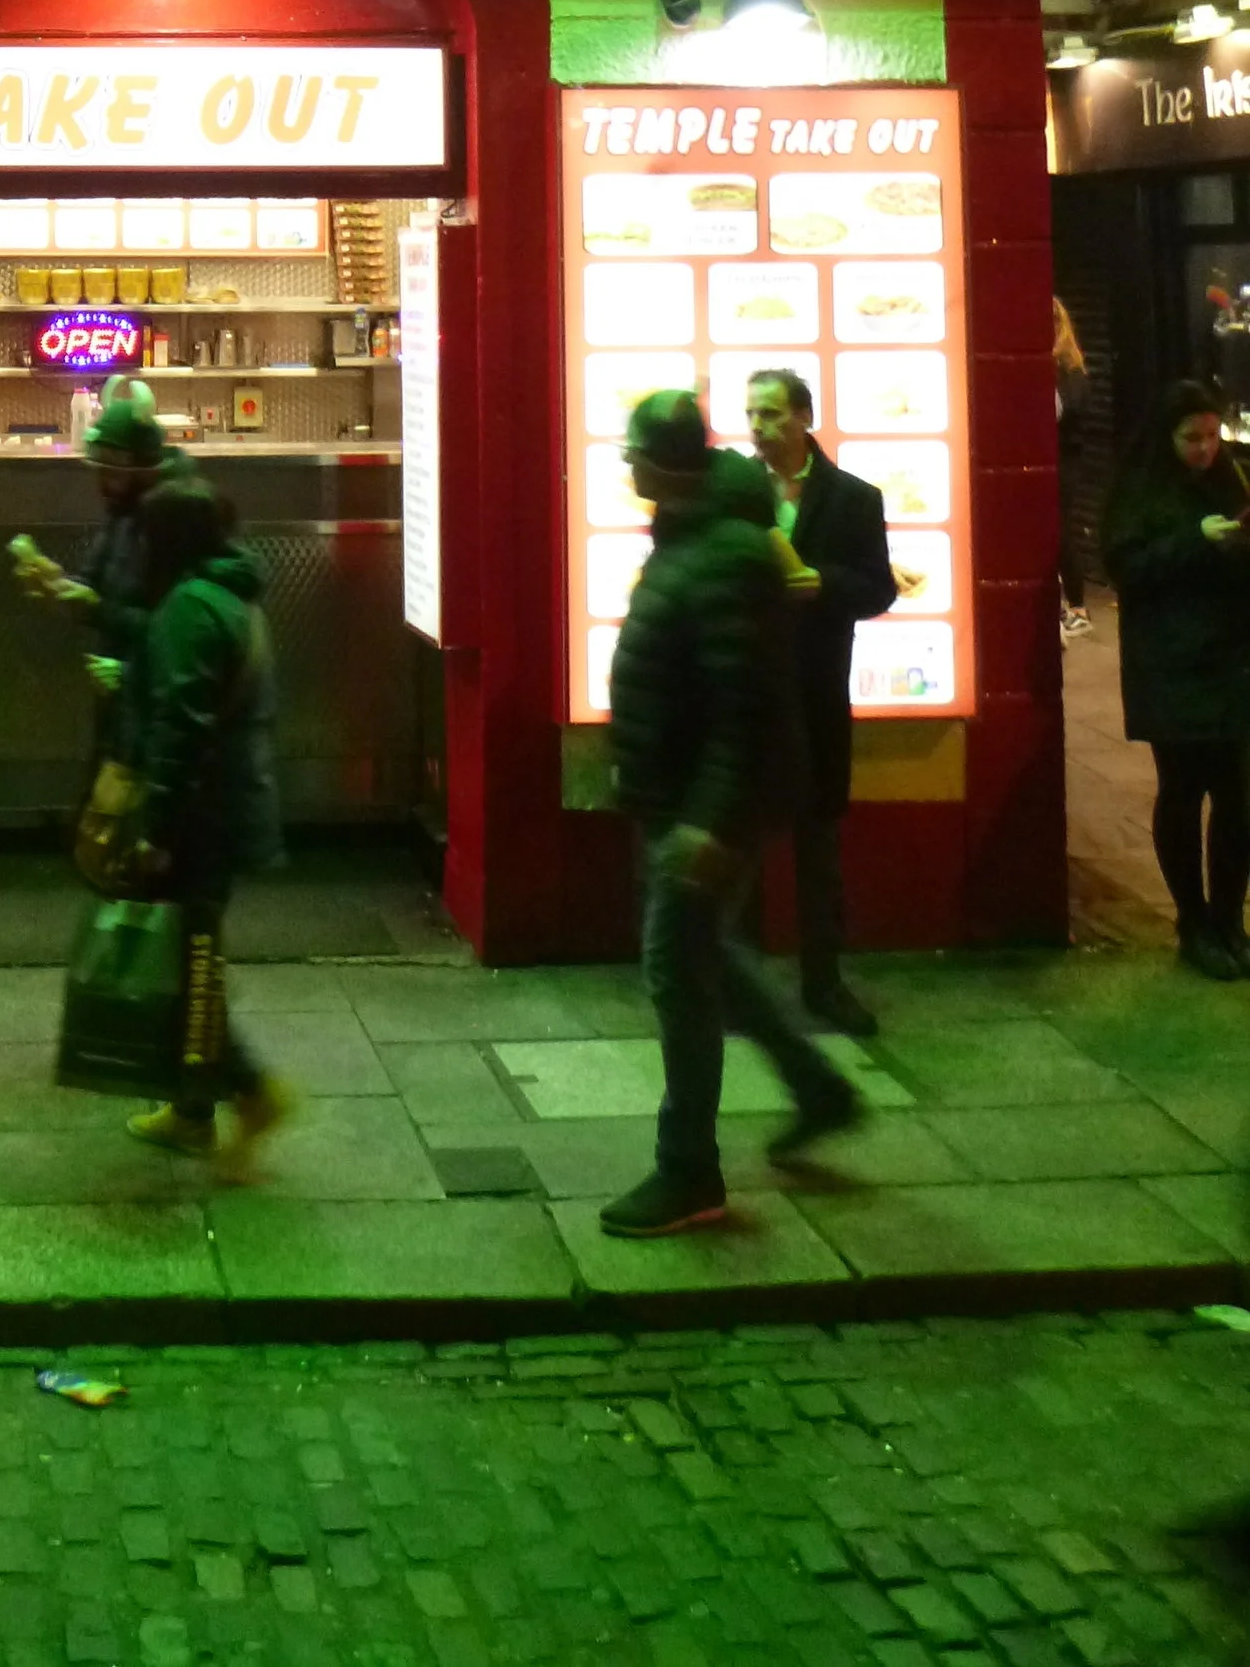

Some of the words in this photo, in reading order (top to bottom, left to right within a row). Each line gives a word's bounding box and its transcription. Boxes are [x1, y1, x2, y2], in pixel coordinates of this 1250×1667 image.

[196, 72, 384, 146] OUT
[1134, 78, 1192, 126] The
[582, 107, 761, 156] TEMPLE
[769, 118, 857, 157] TAKE
[866, 118, 939, 154] OUT
[41, 327, 139, 358] OPEN
